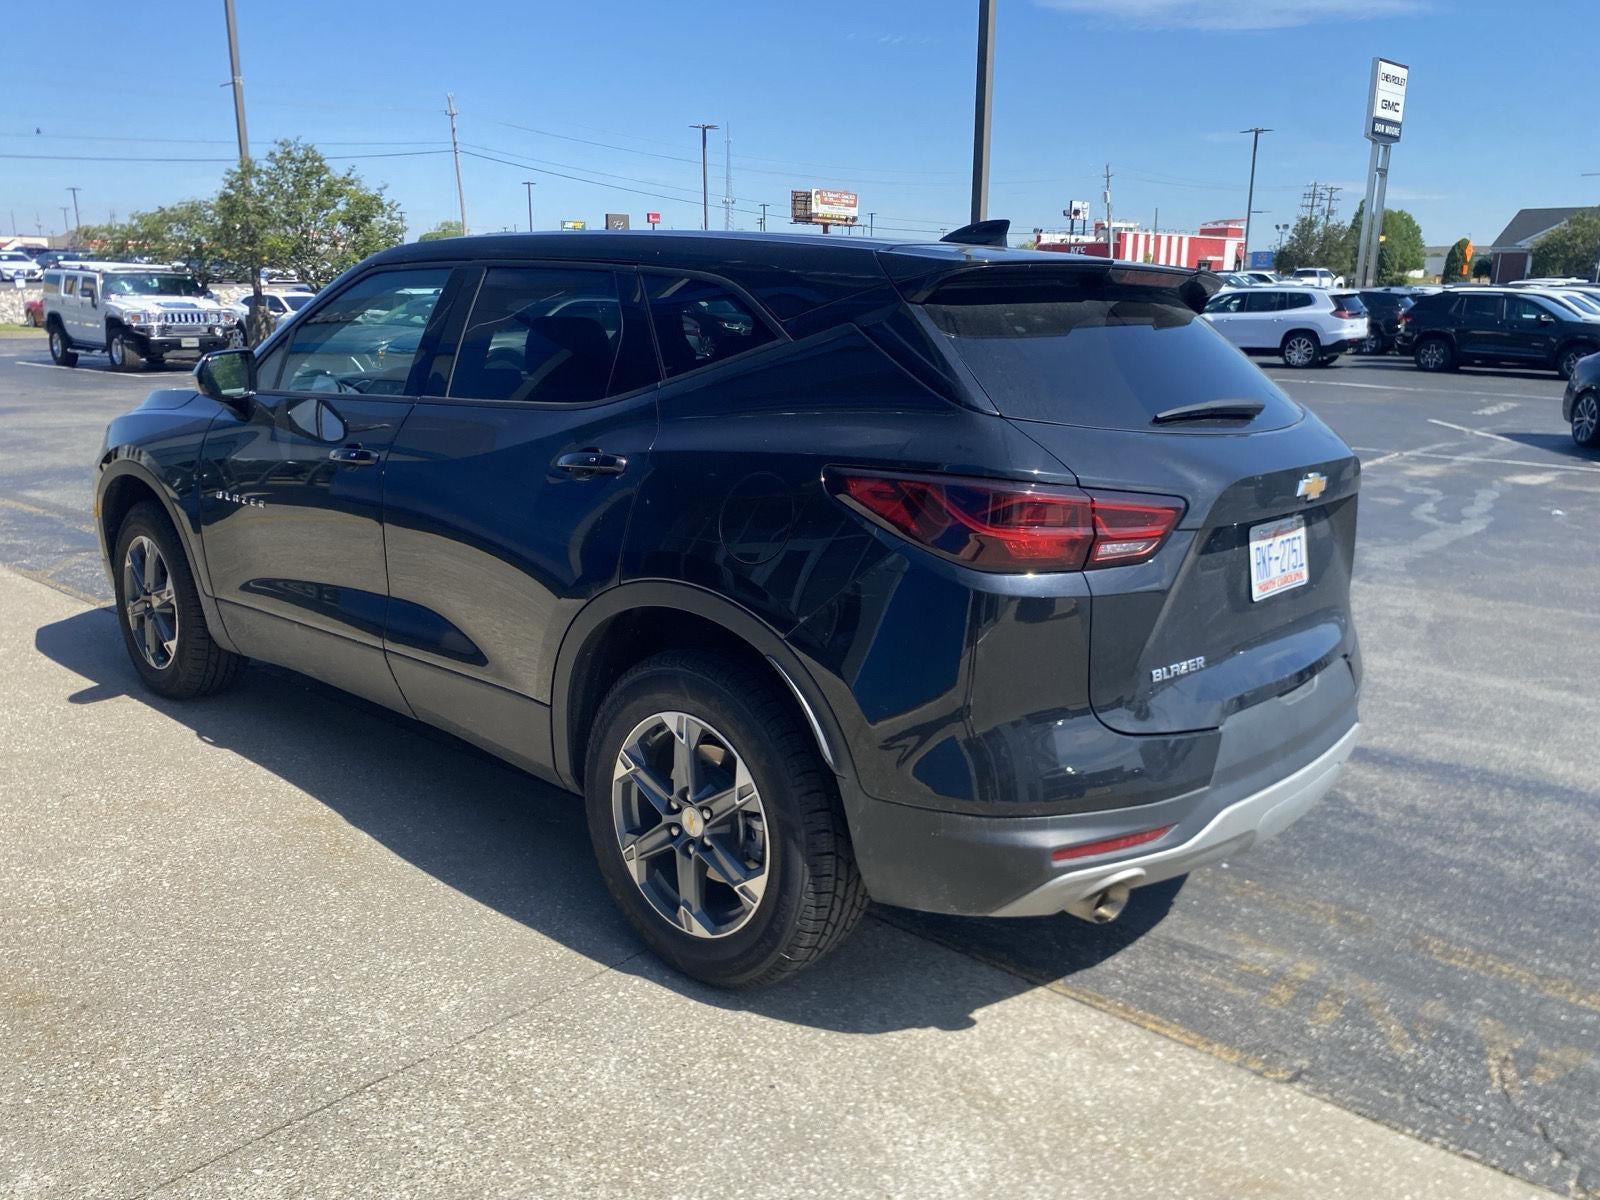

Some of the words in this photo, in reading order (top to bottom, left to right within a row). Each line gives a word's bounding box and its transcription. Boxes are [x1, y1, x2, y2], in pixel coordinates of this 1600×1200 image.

[1381, 72, 1406, 86] CHEVROLET
[1381, 99, 1400, 113] GMC
[1070, 245, 1087, 254] KFC
[215, 490, 265, 509] BLAZER
[1151, 656, 1205, 682] BLAZER
